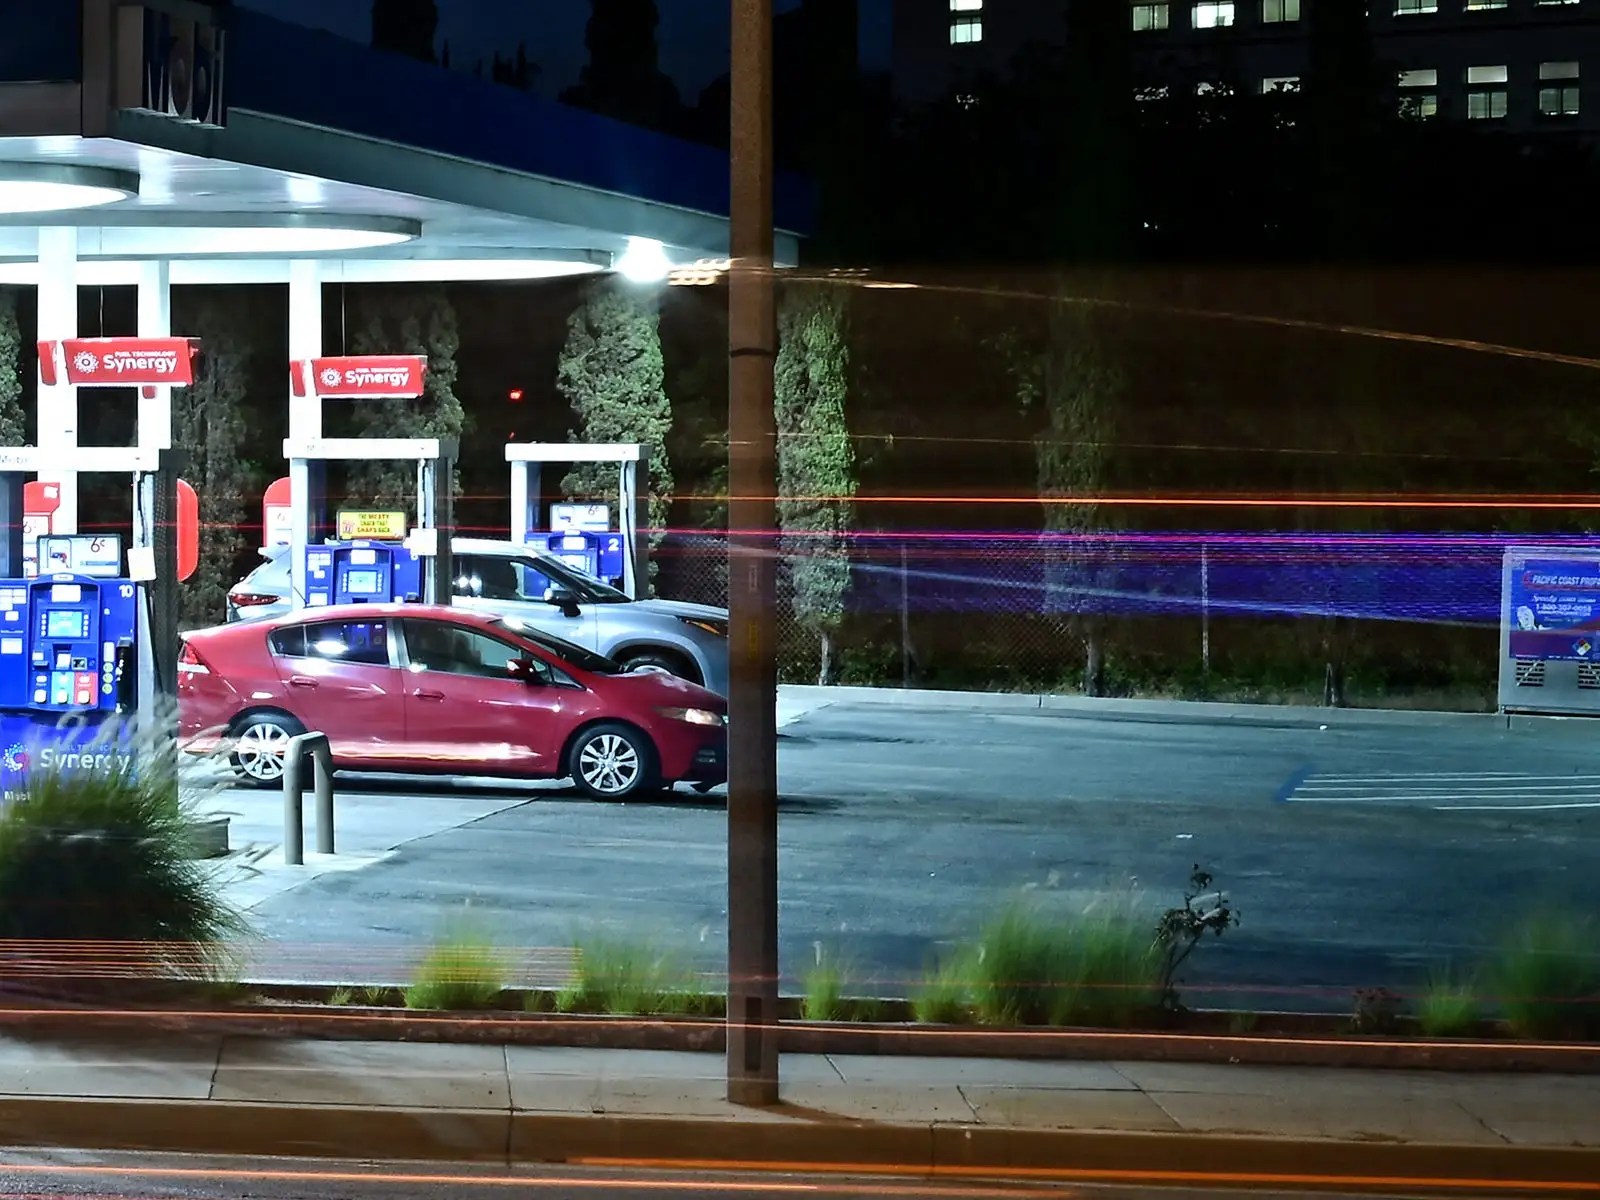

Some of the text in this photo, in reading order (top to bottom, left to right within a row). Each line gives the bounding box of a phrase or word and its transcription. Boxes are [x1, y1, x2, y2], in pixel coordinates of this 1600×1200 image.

[103, 354, 177, 374] Synergy
[345, 369, 410, 387] Synergy
[608, 538, 619, 552] 2
[119, 584, 134, 598] 10
